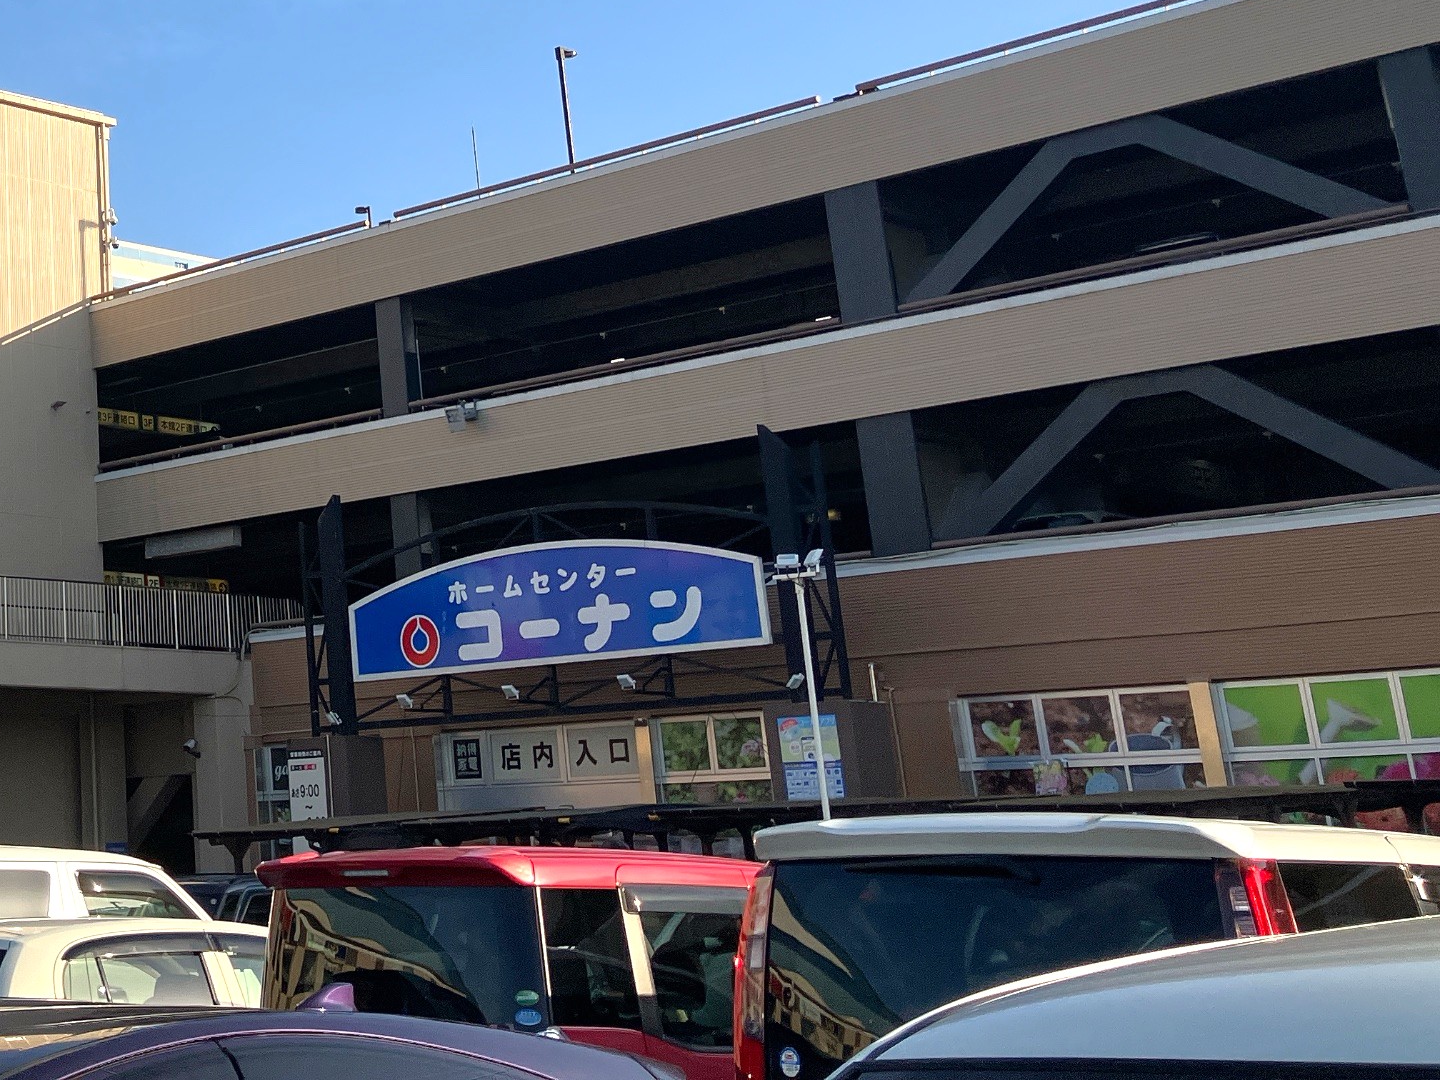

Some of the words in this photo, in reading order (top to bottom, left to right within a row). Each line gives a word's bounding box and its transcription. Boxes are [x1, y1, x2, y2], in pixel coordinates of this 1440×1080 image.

[143, 418, 153, 428] 3F
[448, 563, 636, 605] ホームセンター
[456, 586, 702, 661] コーナン
[501, 738, 630, 771] 店内入口
[274, 765, 289, 781] ga
